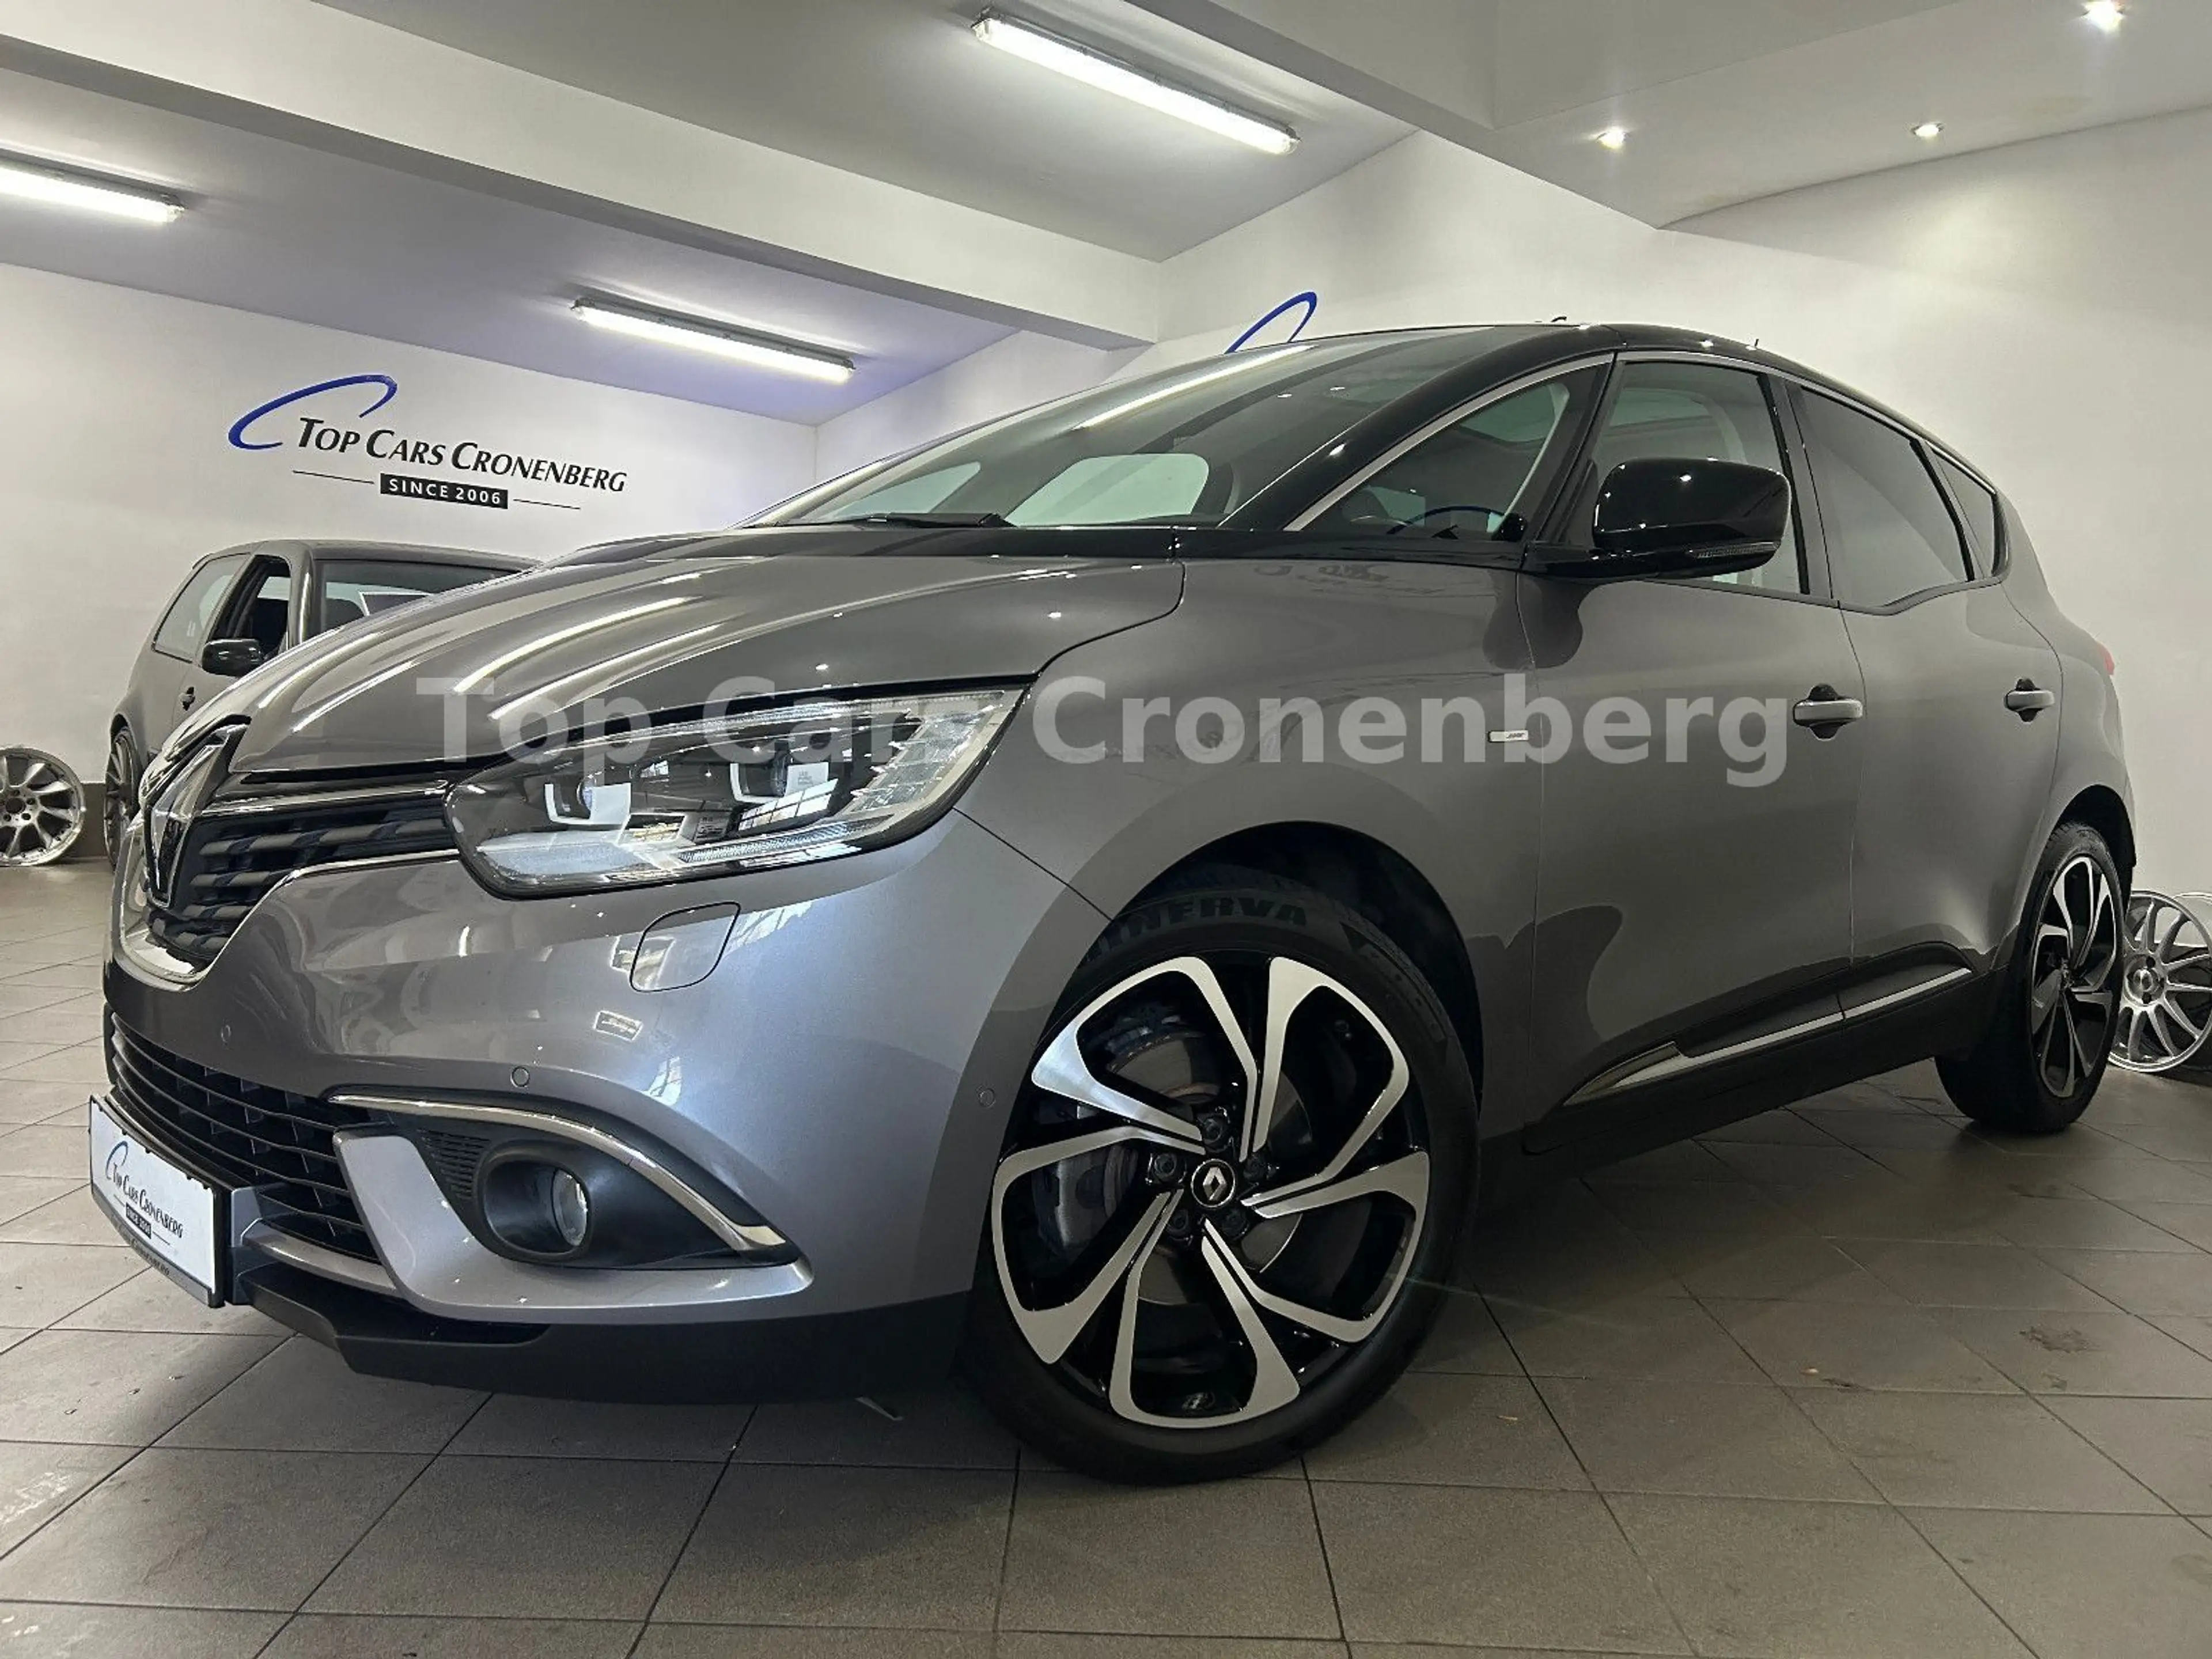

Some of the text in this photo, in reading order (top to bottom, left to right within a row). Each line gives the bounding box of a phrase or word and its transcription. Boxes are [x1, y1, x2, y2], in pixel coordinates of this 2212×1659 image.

[298, 417, 627, 492] TOP CARS CRONENBERG
[389, 478, 500, 505] SINCE 2006
